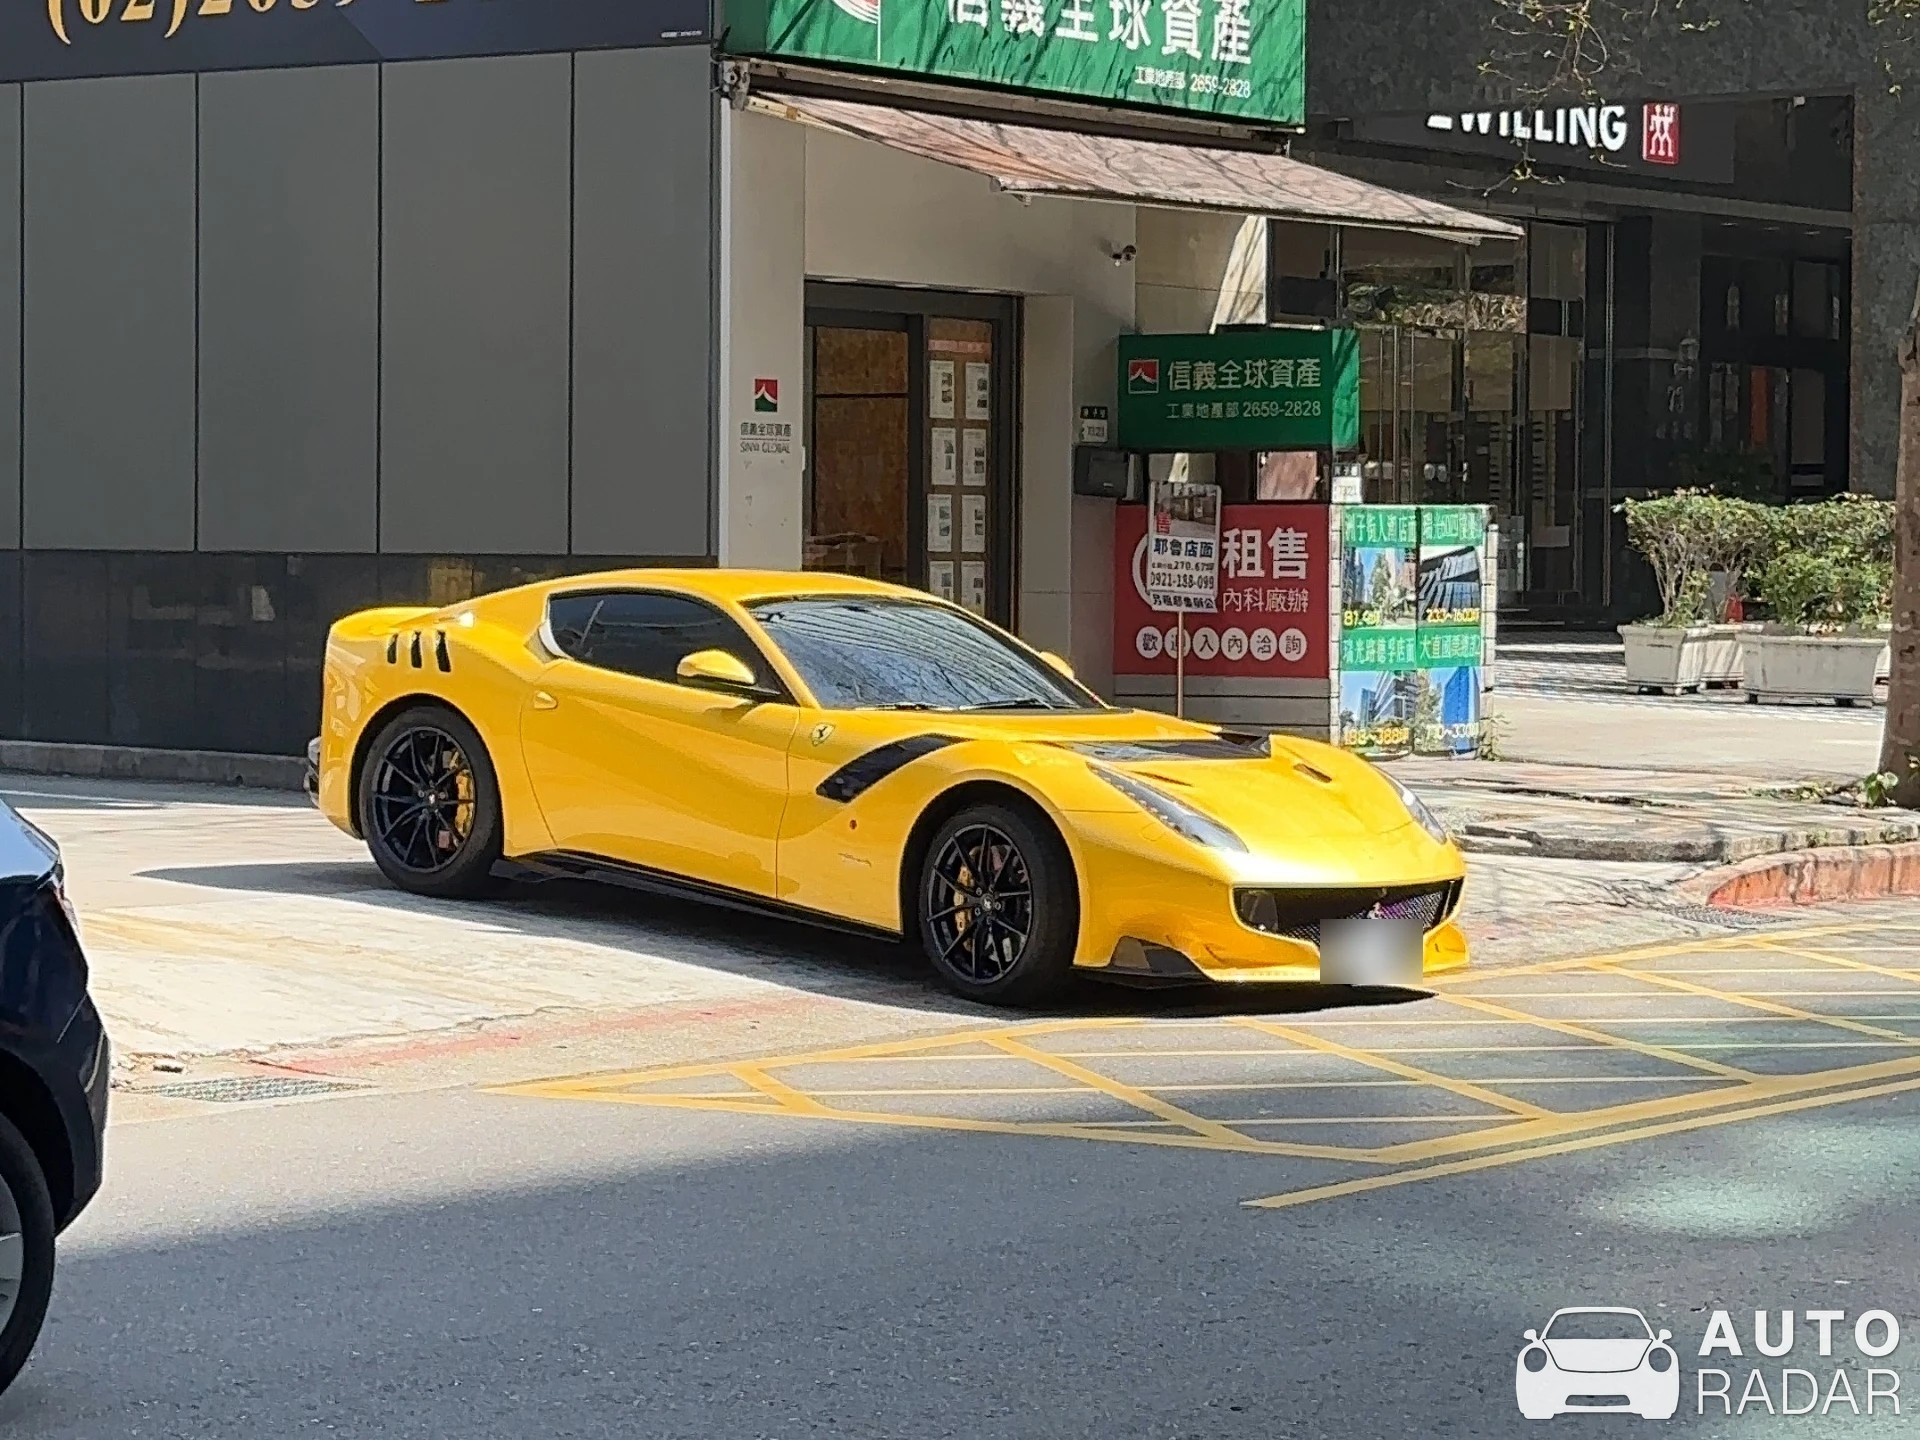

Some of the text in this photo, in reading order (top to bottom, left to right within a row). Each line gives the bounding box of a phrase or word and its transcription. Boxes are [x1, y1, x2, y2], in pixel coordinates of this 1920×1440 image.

[1167, 358, 1321, 391] 信義全球資產
[1243, 401, 1322, 417] 2659-2828
[1221, 526, 1310, 580] 租售
[1222, 587, 1309, 613] 內科廠辦
